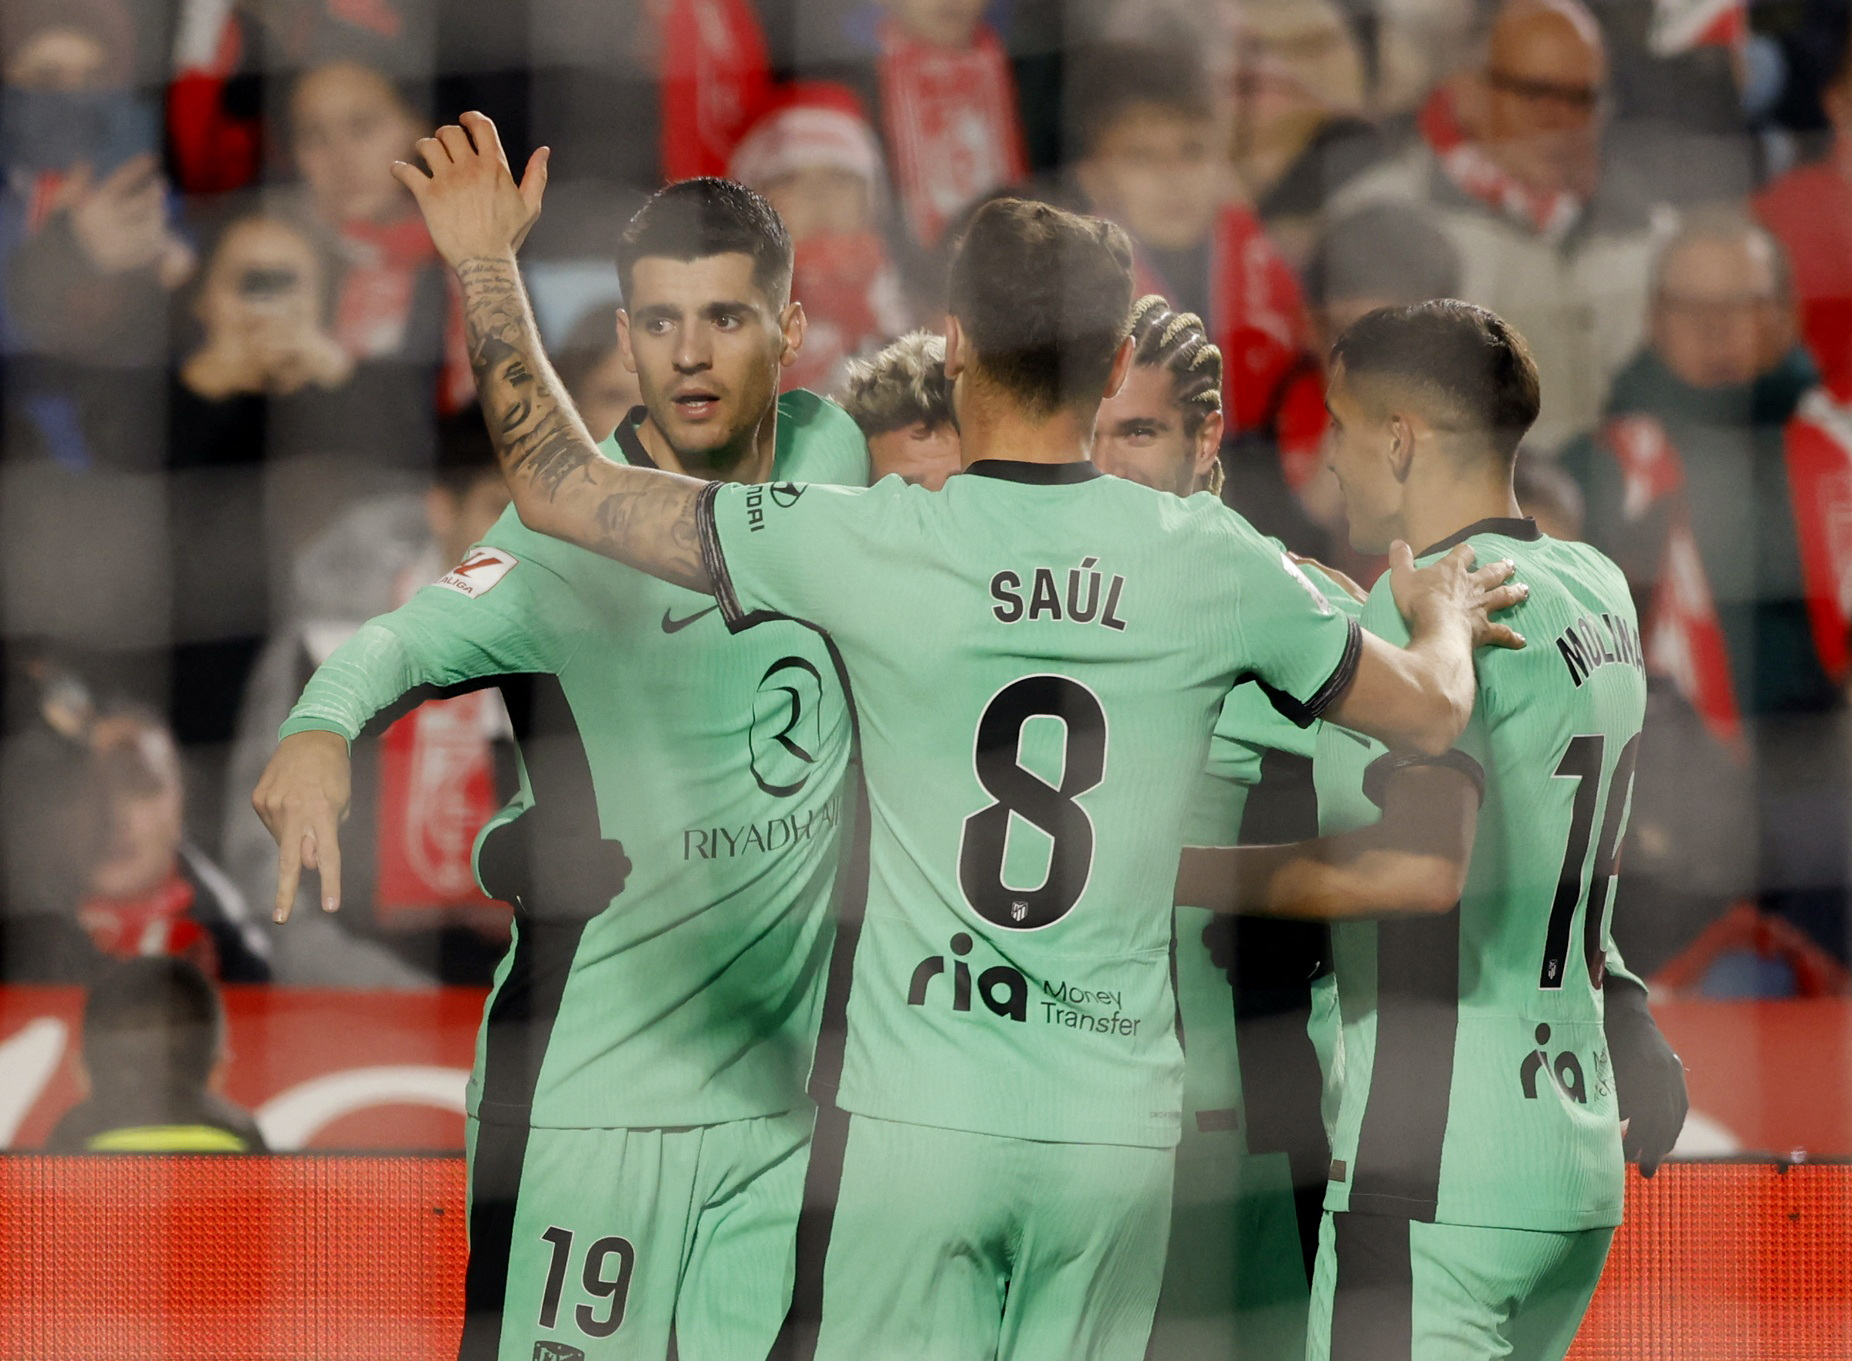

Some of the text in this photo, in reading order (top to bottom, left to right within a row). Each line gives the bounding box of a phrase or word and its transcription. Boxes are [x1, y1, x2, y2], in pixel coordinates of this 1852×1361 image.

[745, 485, 766, 532] NDAI
[433, 576, 474, 593] ALIGA
[989, 556, 1128, 632] SAÚL
[957, 673, 1109, 932] 8
[684, 810, 813, 860] RIYADH
[907, 931, 1028, 1023] ria
[1043, 980, 1122, 1010] Money
[1041, 1001, 1142, 1037] Transfer
[1520, 1022, 1587, 1104] ria
[538, 1225, 636, 1339] 19
